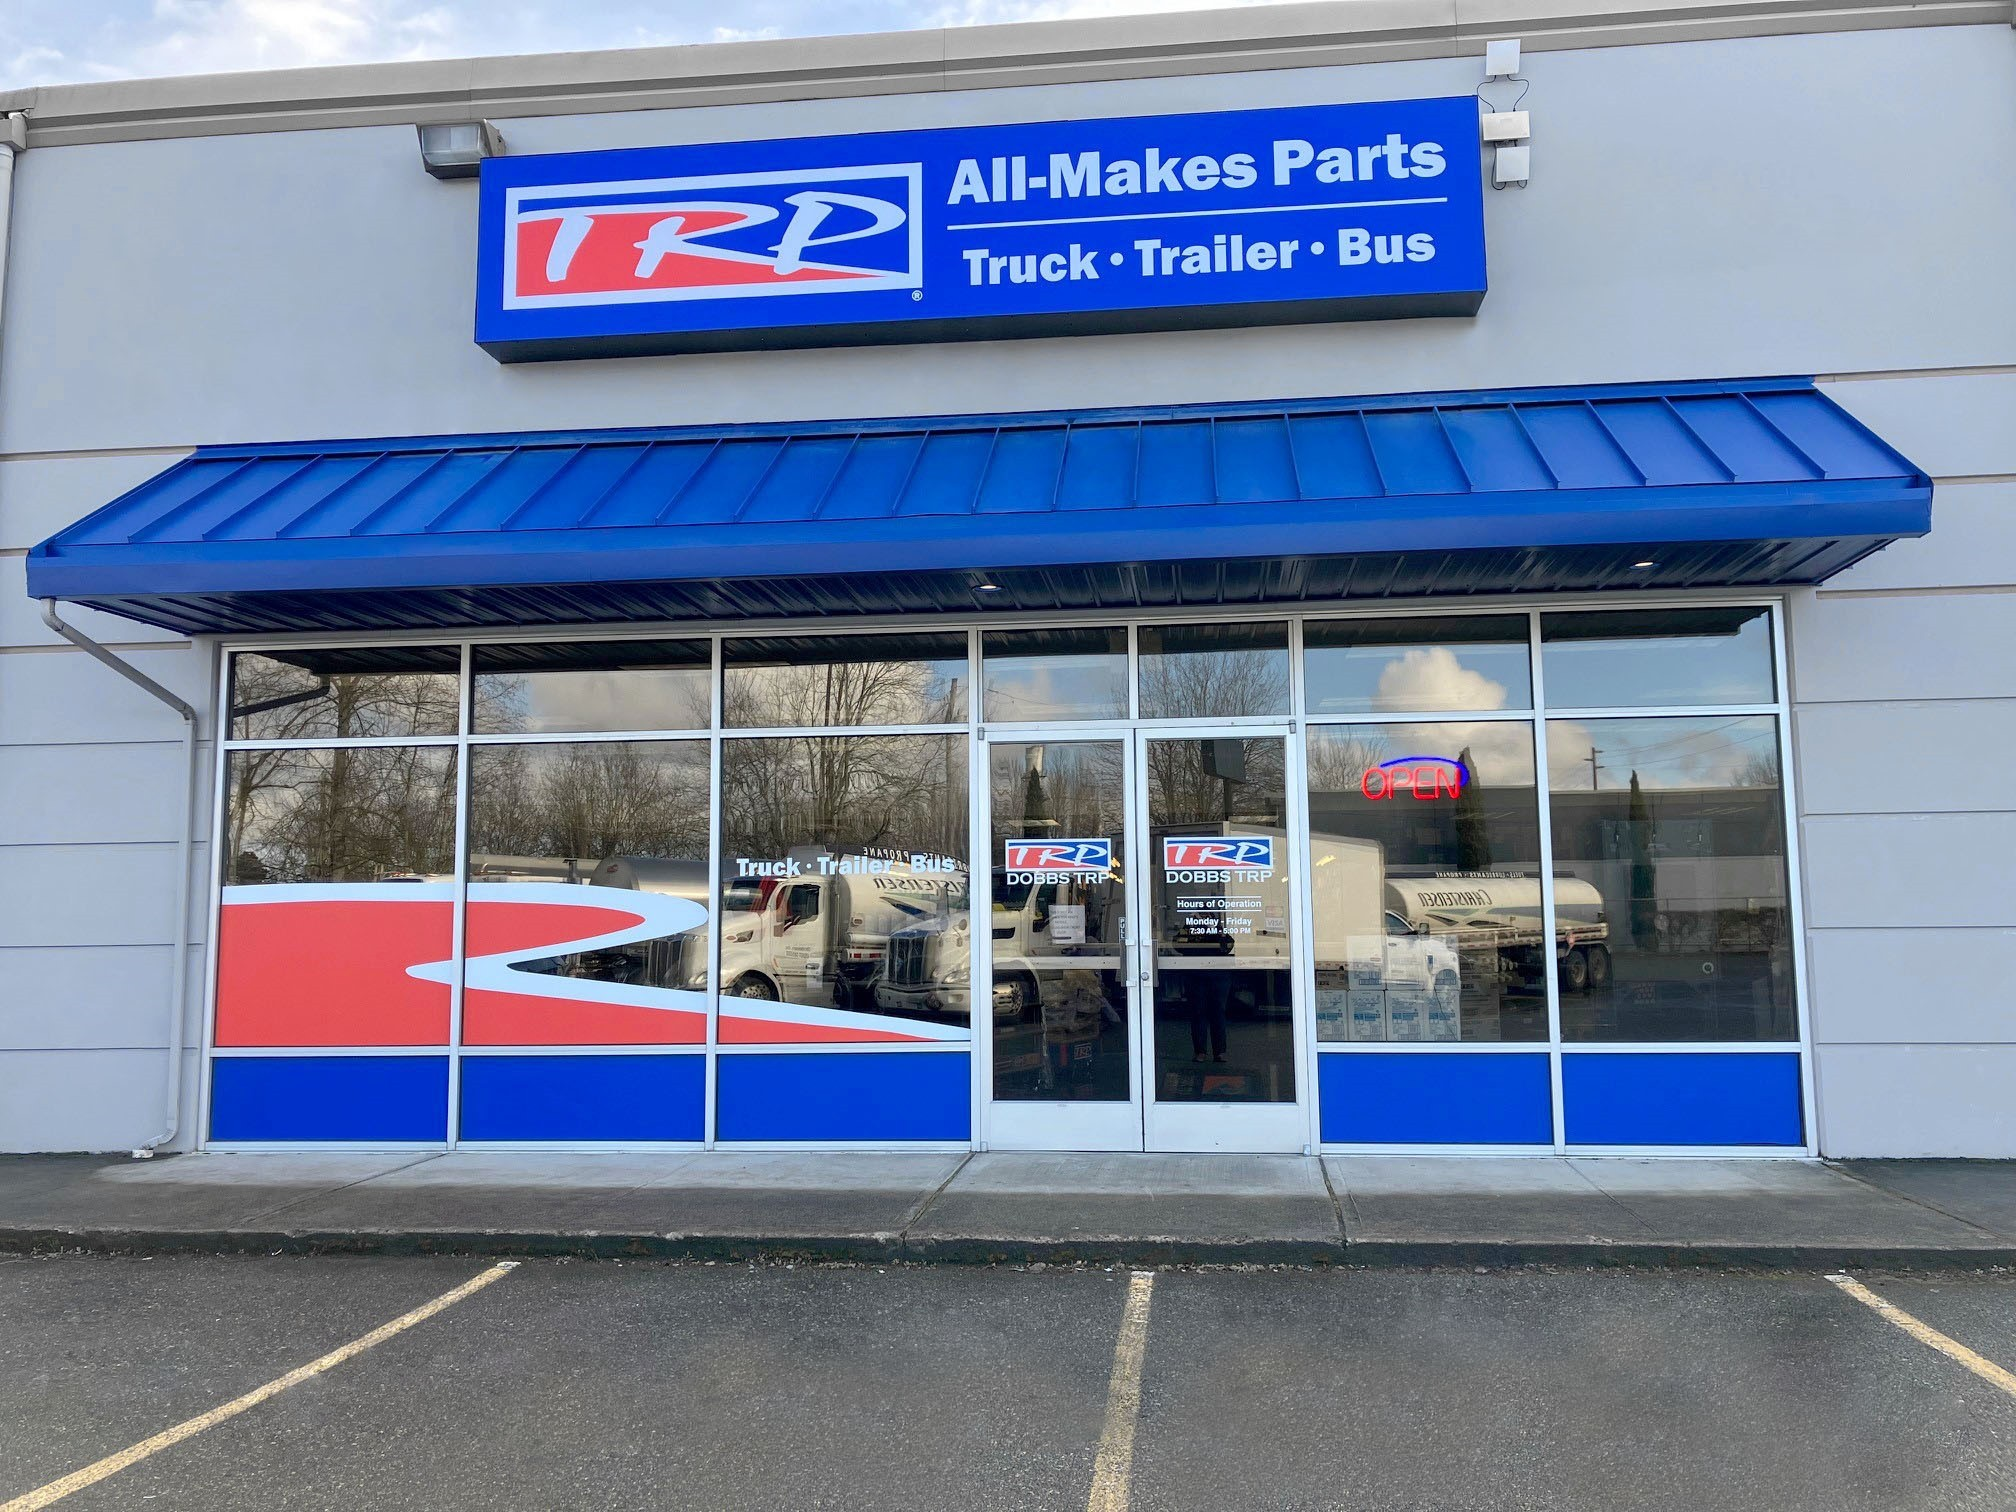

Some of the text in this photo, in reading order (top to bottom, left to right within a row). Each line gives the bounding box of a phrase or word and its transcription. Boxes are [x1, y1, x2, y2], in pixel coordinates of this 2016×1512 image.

[946, 133, 1448, 205] All-Makes Parts
[516, 190, 909, 282] TRP
[961, 227, 1436, 286] Truck Trailer Bus
[1361, 767, 1461, 800] OPEN
[1008, 844, 1108, 866] TRP
[1166, 842, 1270, 865] TRP
[736, 855, 956, 877] Truck Trailer Bus
[1166, 870, 1272, 883] DOBBS TRP
[1007, 872, 1111, 885] DOBBS TRP
[1177, 899, 1261, 910] Hours of Operation
[1186, 917, 1219, 927] Monday
[1226, 917, 1252, 926] Friday
